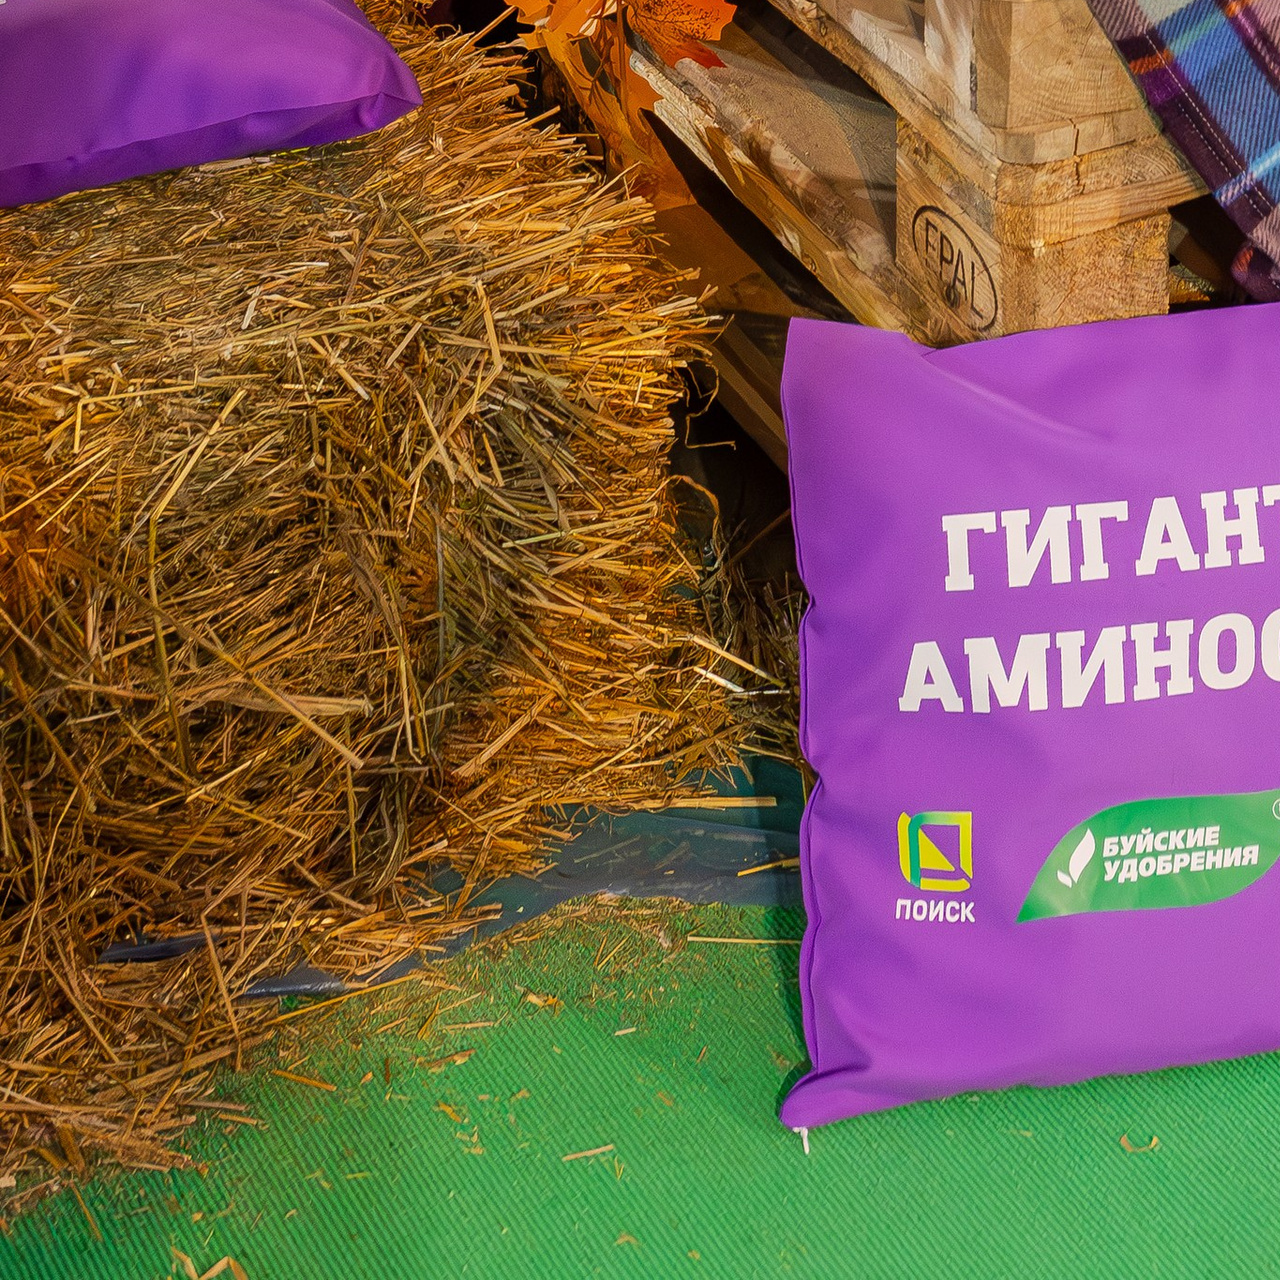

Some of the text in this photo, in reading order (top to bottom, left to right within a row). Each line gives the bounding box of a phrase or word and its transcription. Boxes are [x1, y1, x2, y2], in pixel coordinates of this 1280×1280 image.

[1102, 824, 1220, 858] БУЙСКИЕ
[1103, 843, 1260, 884] УДОБРЕНИЯ
[895, 898, 976, 924] ПОИСК
